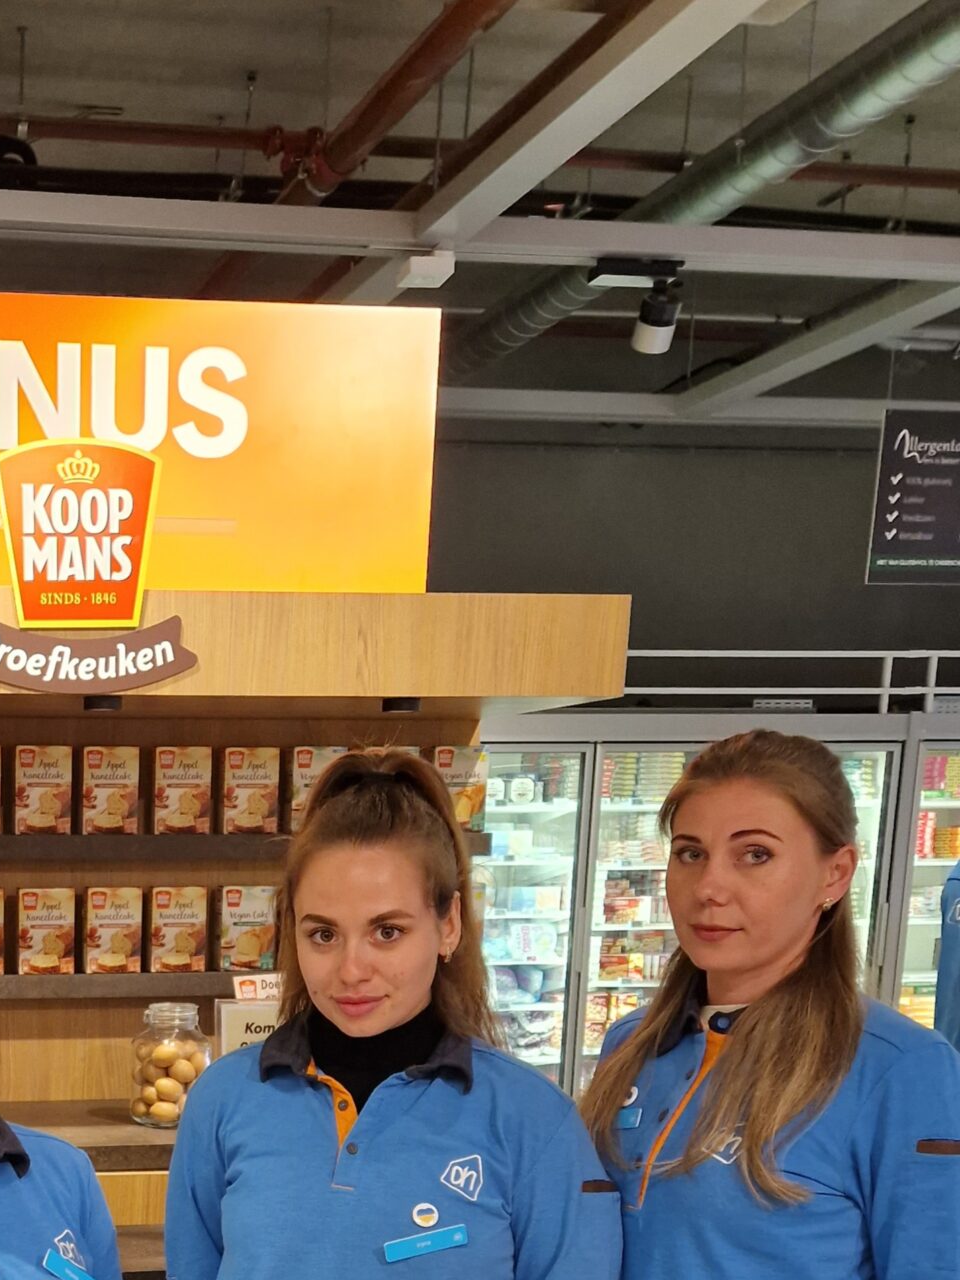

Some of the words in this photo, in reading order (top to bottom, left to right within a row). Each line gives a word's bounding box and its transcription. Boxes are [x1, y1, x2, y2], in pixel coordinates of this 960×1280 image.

[21, 483, 134, 535] KOOP
[21, 535, 133, 582] MANS
[40, 592, 81, 606] SINDS
[90, 591, 117, 605] 1846
